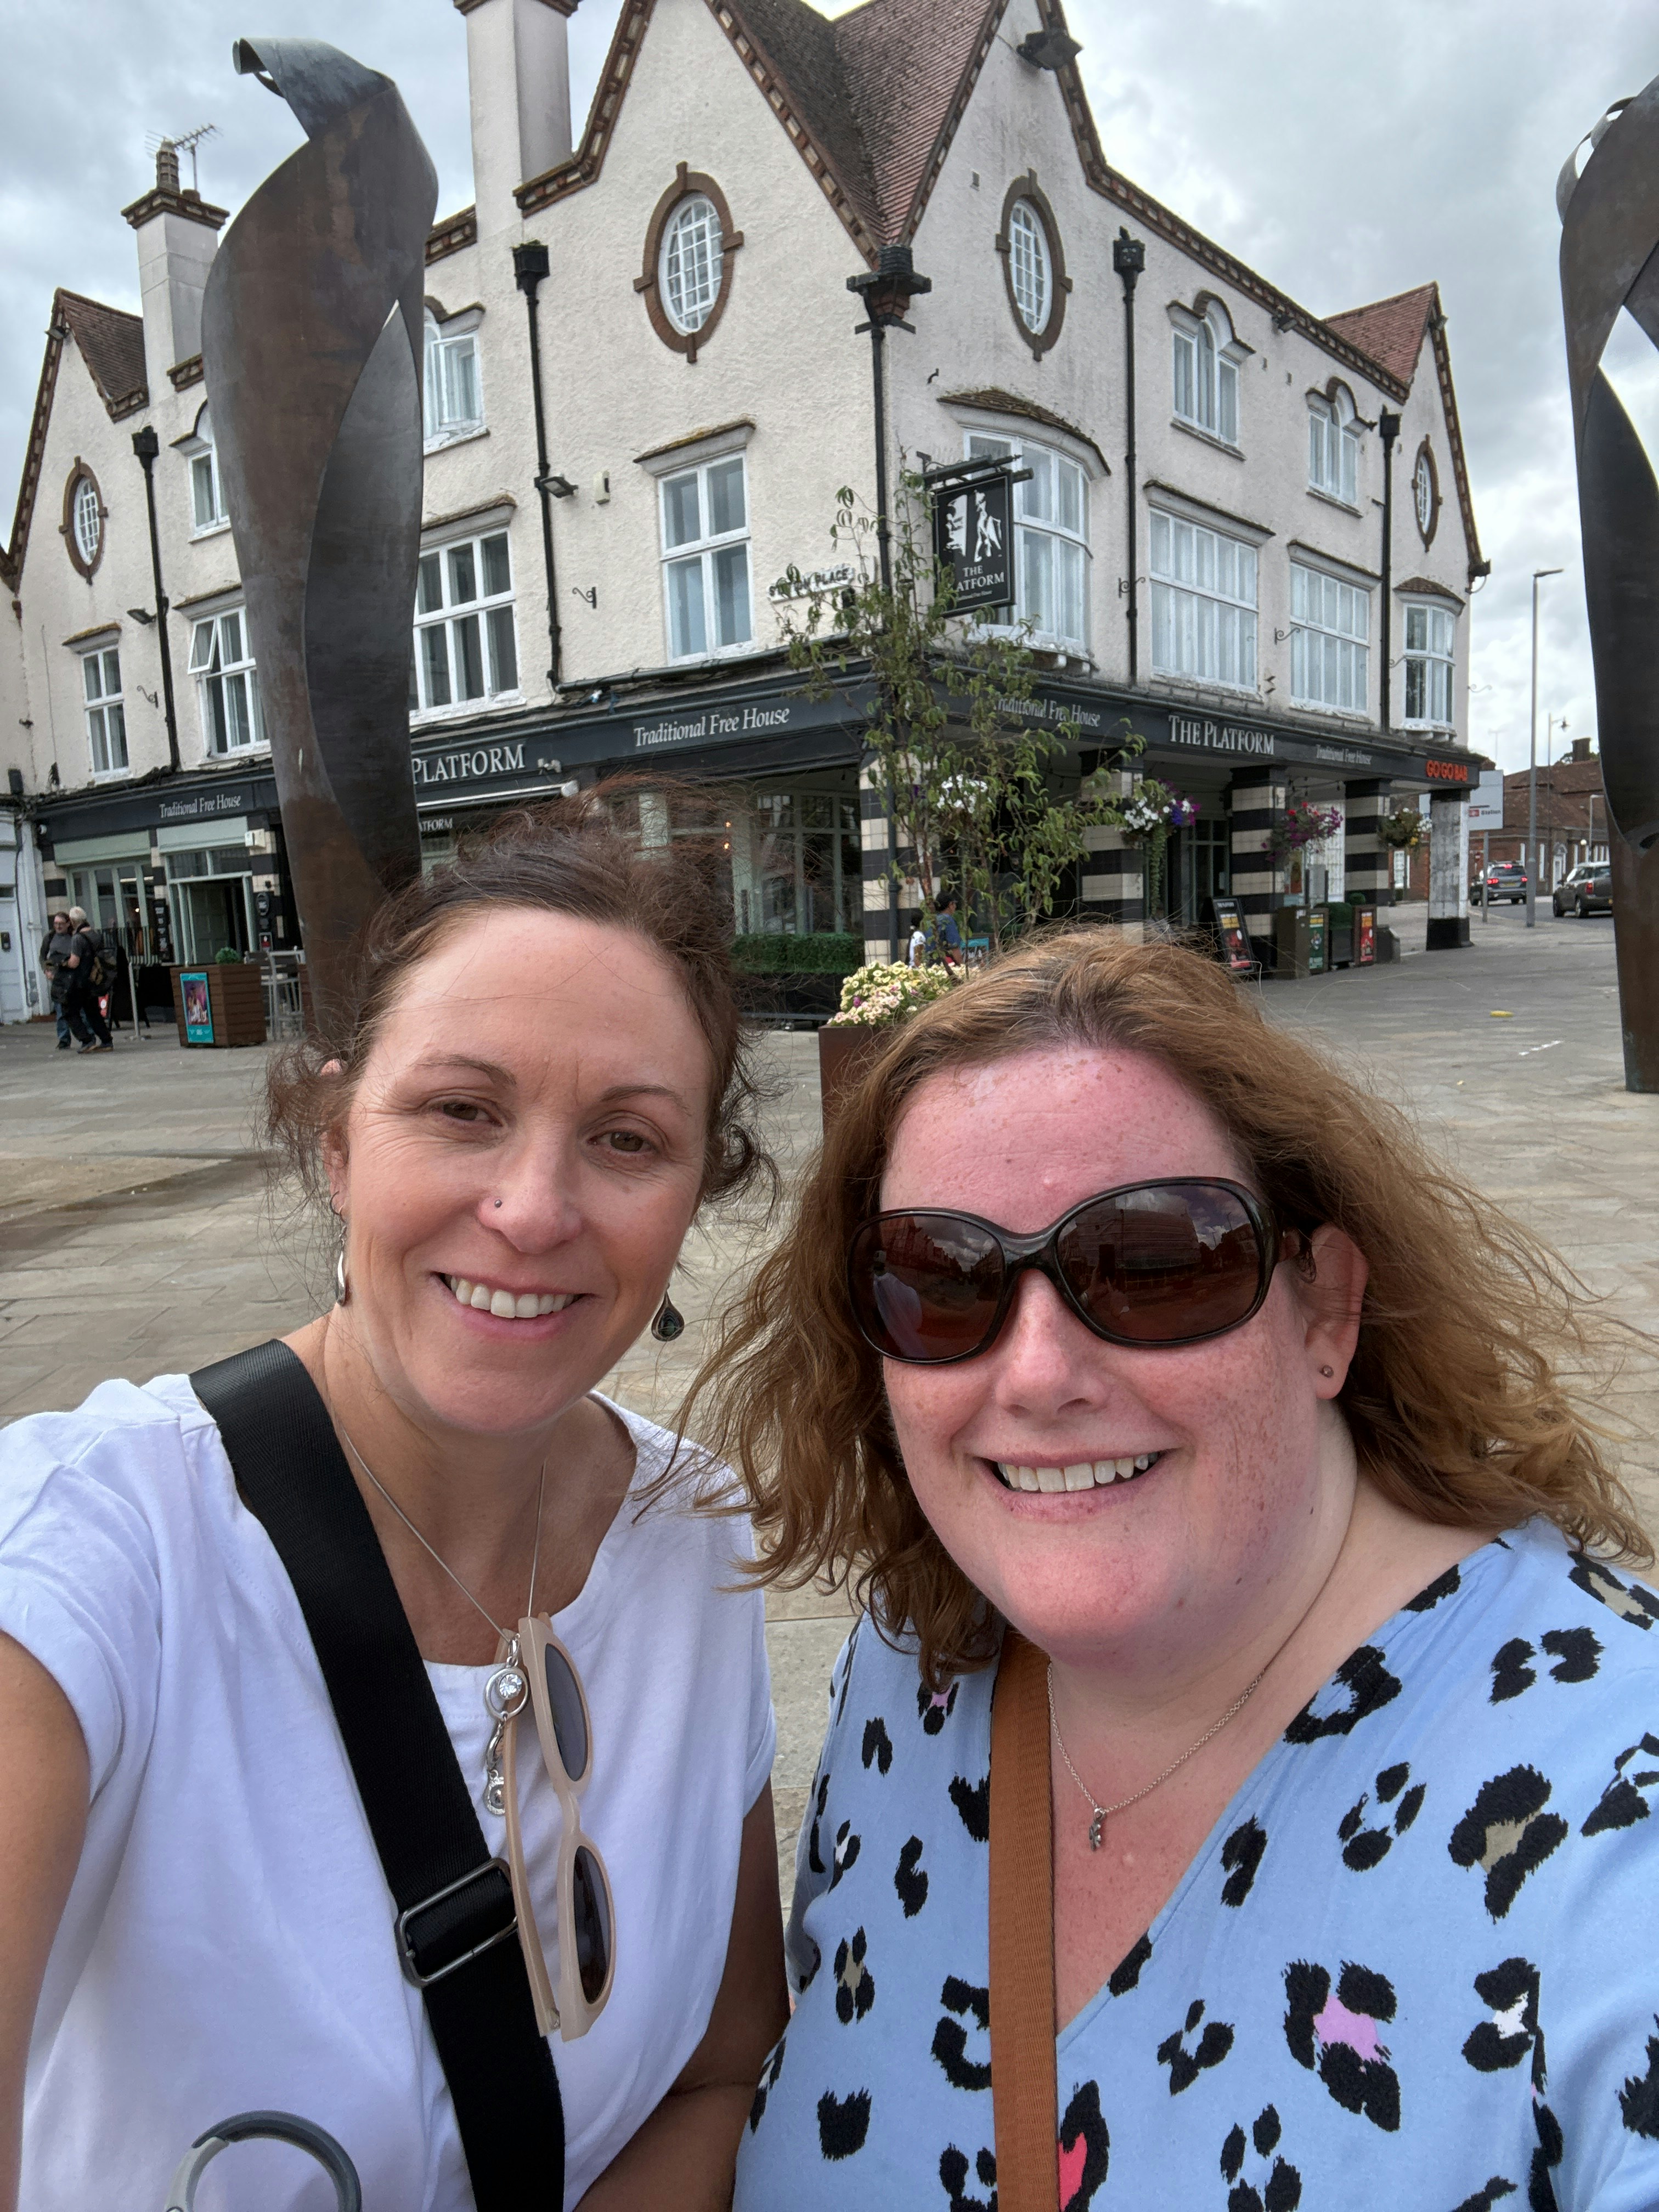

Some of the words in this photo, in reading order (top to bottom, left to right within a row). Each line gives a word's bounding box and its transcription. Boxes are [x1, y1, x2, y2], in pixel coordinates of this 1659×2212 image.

[956, 572, 1005, 592] ATFORM
[963, 566, 983, 577] THE
[994, 697, 1047, 718] raditional
[1071, 704, 1101, 727] House
[634, 716, 706, 747] Traditional
[709, 714, 740, 734] Free
[742, 708, 790, 729] House
[1168, 715, 1201, 745] THE
[1204, 720, 1274, 755] PLATFORM
[411, 744, 526, 785] PLATFORM
[1426, 759, 1440, 778] GO
[1441, 763, 1454, 780] GO
[159, 798, 198, 818] Traditional
[200, 797, 215, 812] Free
[217, 794, 241, 810] House
[417, 817, 453, 832] ATFORM
